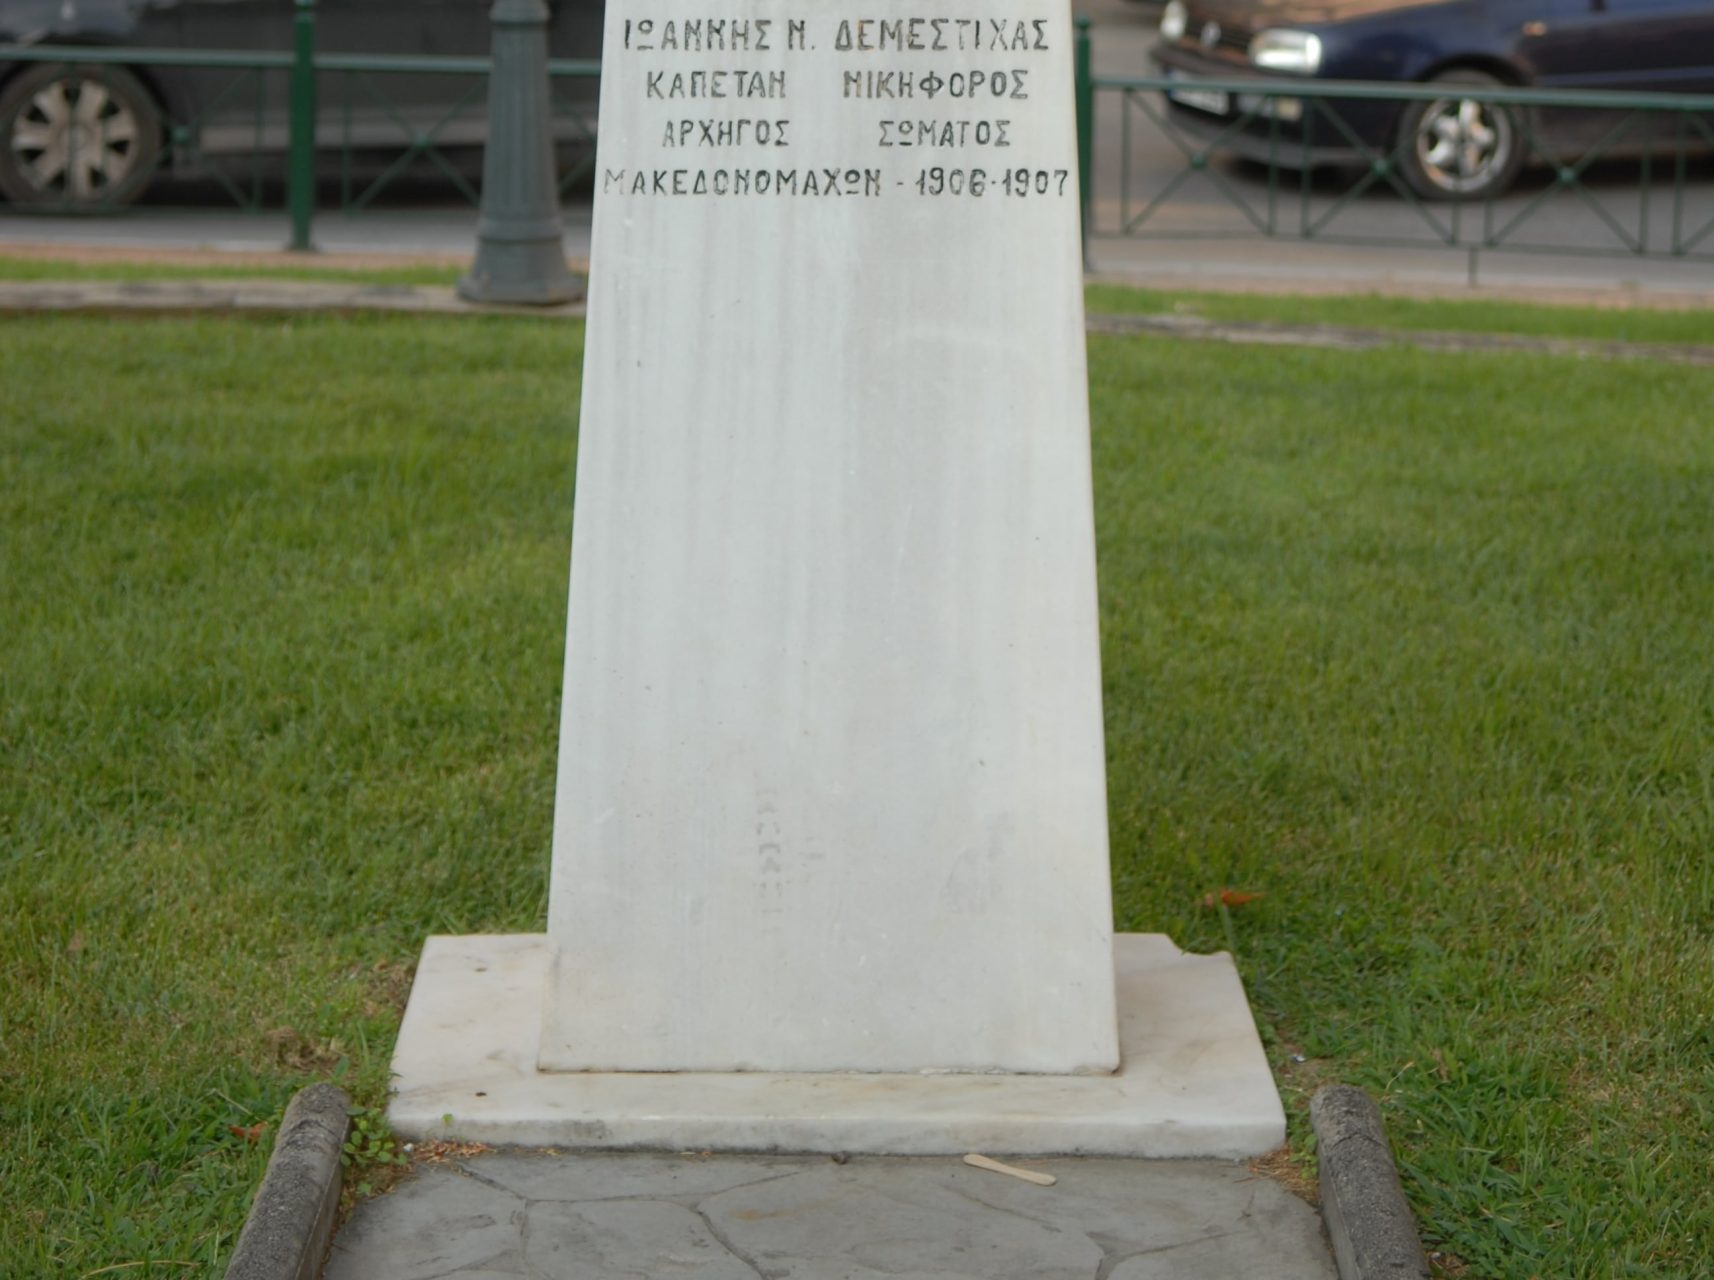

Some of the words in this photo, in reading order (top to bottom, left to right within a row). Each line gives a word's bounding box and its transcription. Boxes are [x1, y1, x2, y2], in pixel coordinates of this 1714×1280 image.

[624, 18, 772, 51] ΙΩΑΝΝΗΣ
[788, 19, 818, 51] Ν.
[834, 18, 1049, 52] ΔΕΜΕΣΤΙΧΑΣ
[646, 70, 786, 99] ΚΑΠΕΤΑΝ
[843, 69, 1029, 99] ΝΙΚΗΦΟΡΟΣ
[662, 119, 790, 148] ΑΡΧΗΓΟΣ
[878, 120, 1011, 147] ΣΩΜΑΤΟΣ
[603, 168, 881, 197] ΜΑΚΕΔΟΝΟΜΑΧΩΝ
